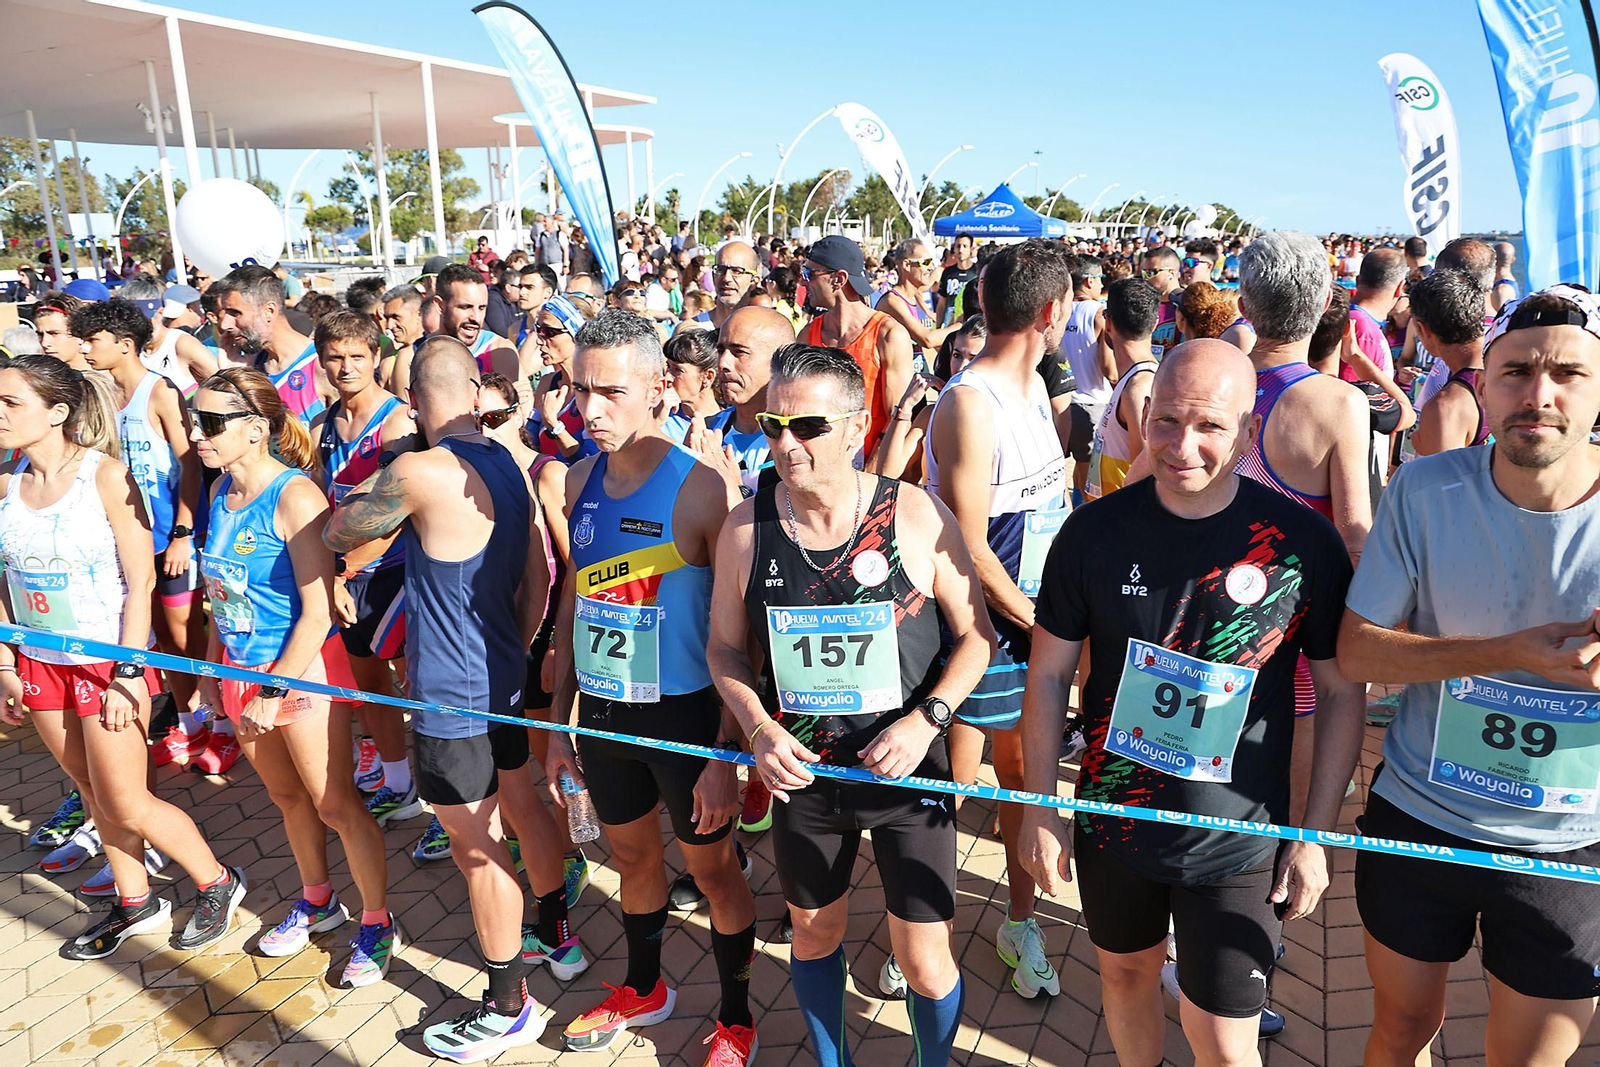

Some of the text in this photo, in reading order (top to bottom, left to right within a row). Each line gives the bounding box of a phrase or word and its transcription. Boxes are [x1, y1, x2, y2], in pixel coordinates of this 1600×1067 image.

[955, 224, 1020, 232] Asistencia Sanitaria
[588, 561, 630, 587] CLUB
[765, 578, 784, 587] BY2
[1121, 584, 1148, 597] BY2
[601, 609, 630, 621] AVATEL
[630, 612, 652, 626] '24
[791, 614, 819, 624] HUELVA
[821, 614, 861, 624] AVATEL
[861, 610, 887, 626] '24
[587, 624, 627, 659] 72
[792, 634, 874, 668] 157
[1153, 653, 1180, 671] HUELVA
[1181, 666, 1222, 684] AVATEL
[580, 672, 619, 692] Wayalia
[796, 693, 854, 707] Wayalia
[1152, 682, 1208, 729] 91
[1472, 683, 1509, 701] HUELVA
[1513, 695, 1568, 712] AVATEL
[1155, 737, 1189, 752] FERIA FERIA
[1163, 731, 1184, 743] PEDRO
[1482, 713, 1557, 758] 89
[1129, 735, 1187, 768] Wayalia
[1488, 767, 1539, 784] FABEIRO CRUZ
[1498, 762, 1530, 774] RICARDO
[1459, 767, 1533, 799] Wayalia
[908, 776, 980, 794] HUELVA
[1047, 794, 1127, 813] HUELVA
[1197, 815, 1282, 834] HUELVA
[1362, 836, 1456, 857] HUELVA
[1541, 859, 1600, 876] HUE
